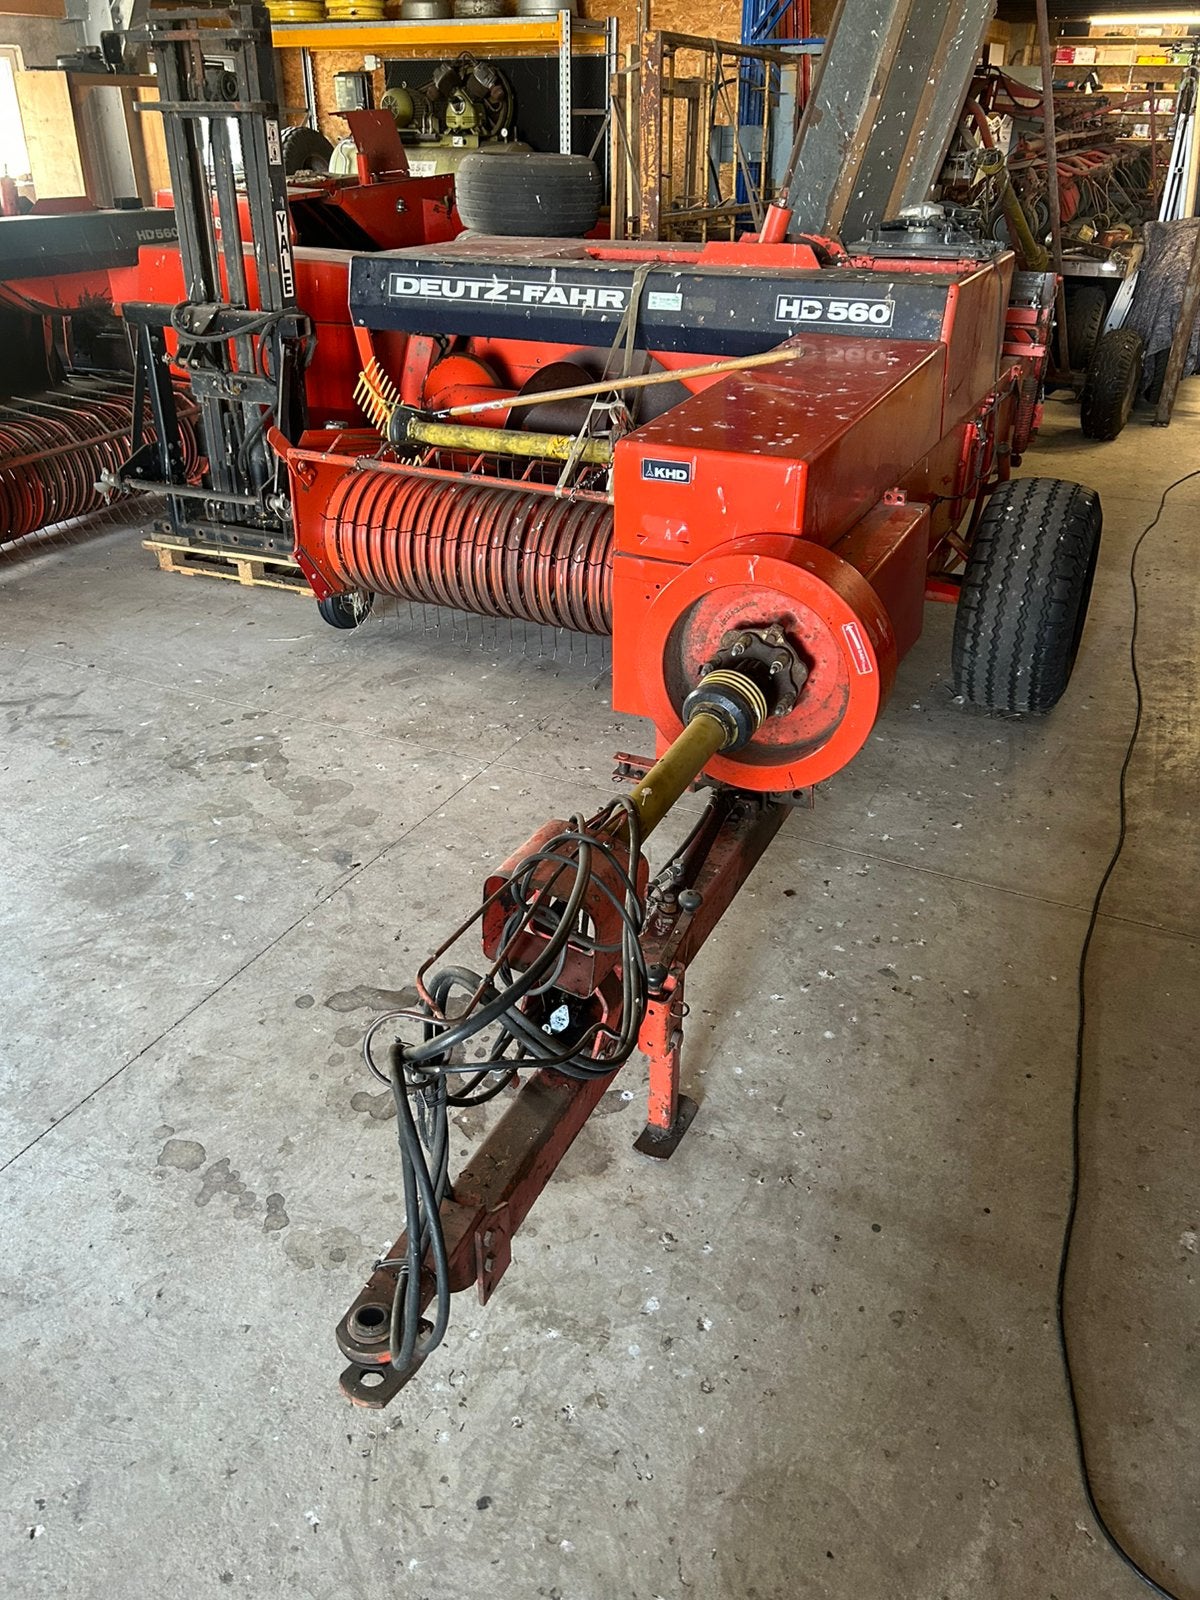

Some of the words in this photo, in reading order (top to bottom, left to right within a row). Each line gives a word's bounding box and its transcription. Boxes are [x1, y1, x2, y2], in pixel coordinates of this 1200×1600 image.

[277, 213, 293, 295] YALE
[395, 276, 625, 309] DEUTZ-FAHR
[778, 298, 822, 320] HD
[827, 302, 891, 324] 560
[654, 467, 688, 481] KHD
